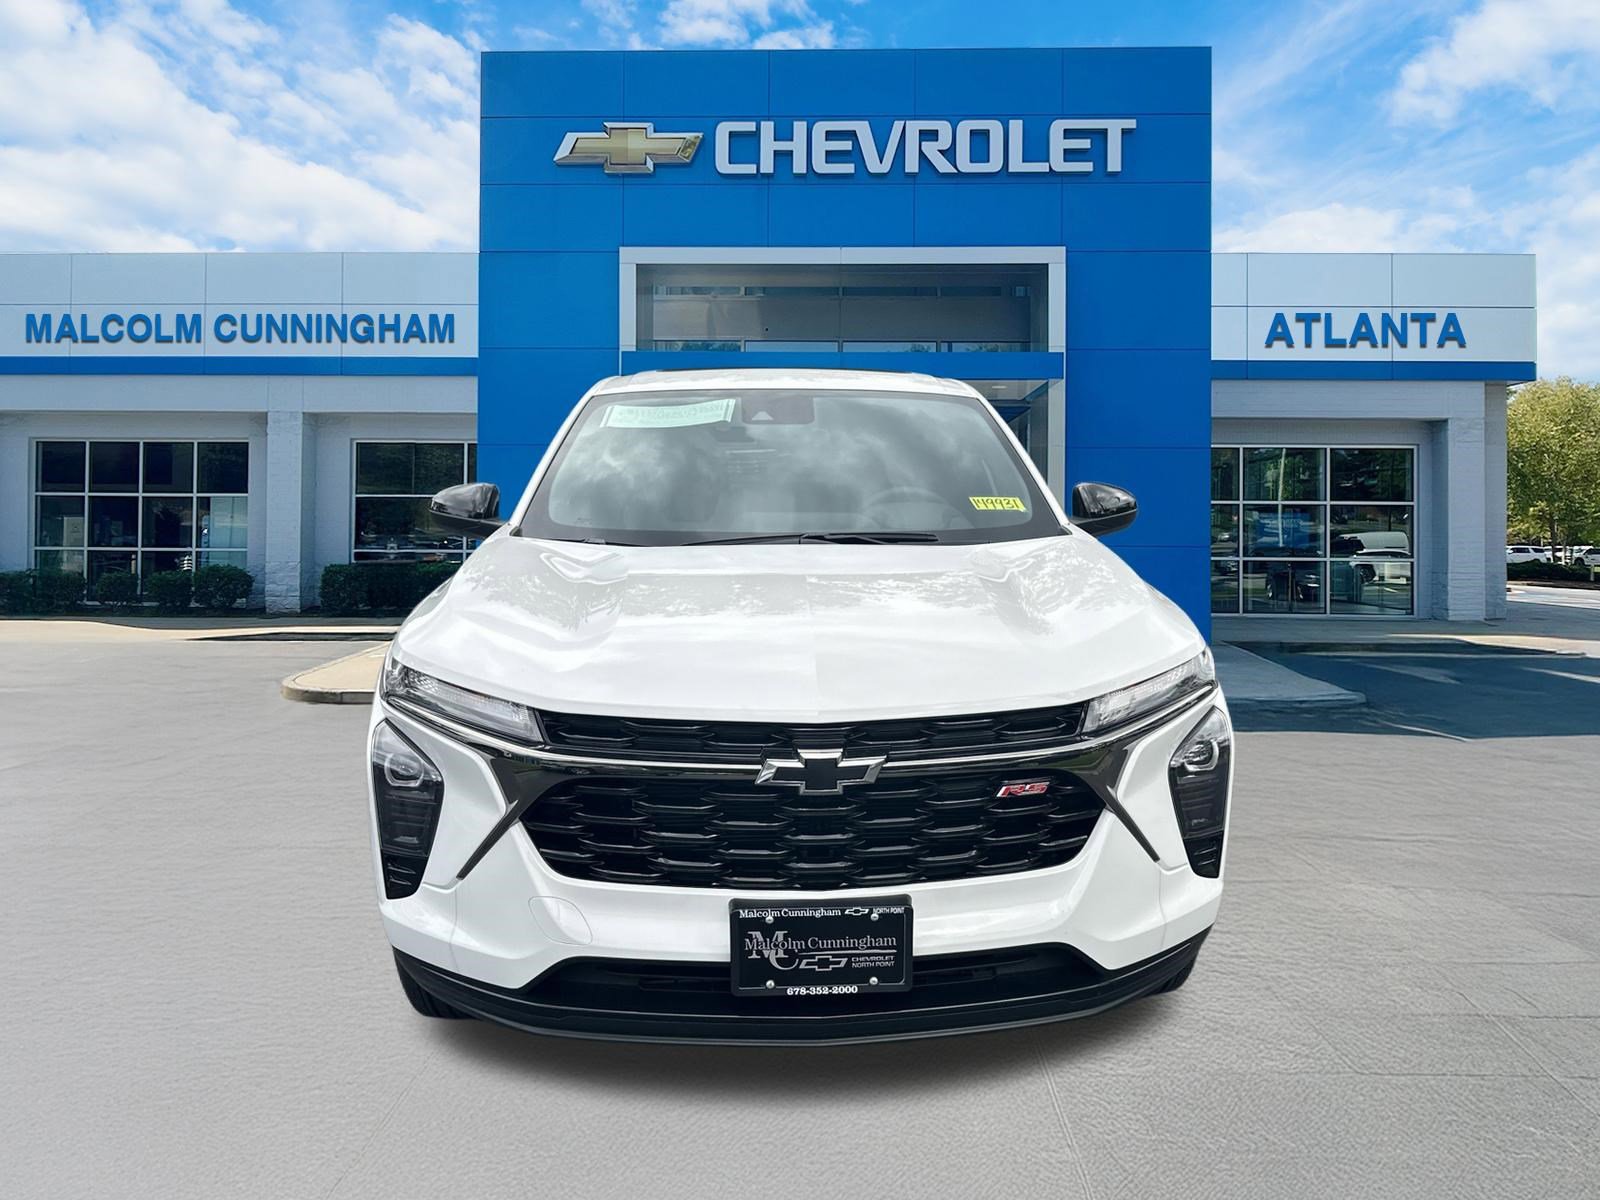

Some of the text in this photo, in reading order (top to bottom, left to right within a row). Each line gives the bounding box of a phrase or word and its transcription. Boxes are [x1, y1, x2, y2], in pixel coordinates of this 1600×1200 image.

[714, 119, 1137, 175] CHEVROLET
[25, 313, 456, 344] MALCOLM CUNNINGHAM
[1264, 312, 1467, 348] ATLANTA
[972, 498, 1020, 510] 149931
[996, 781, 1050, 798] RS
[739, 908, 842, 919] Malcolm Cunningham
[890, 906, 905, 914] POINT
[745, 935, 898, 951] Malcolm Cunningham
[786, 985, 859, 996] 678-352-2000
